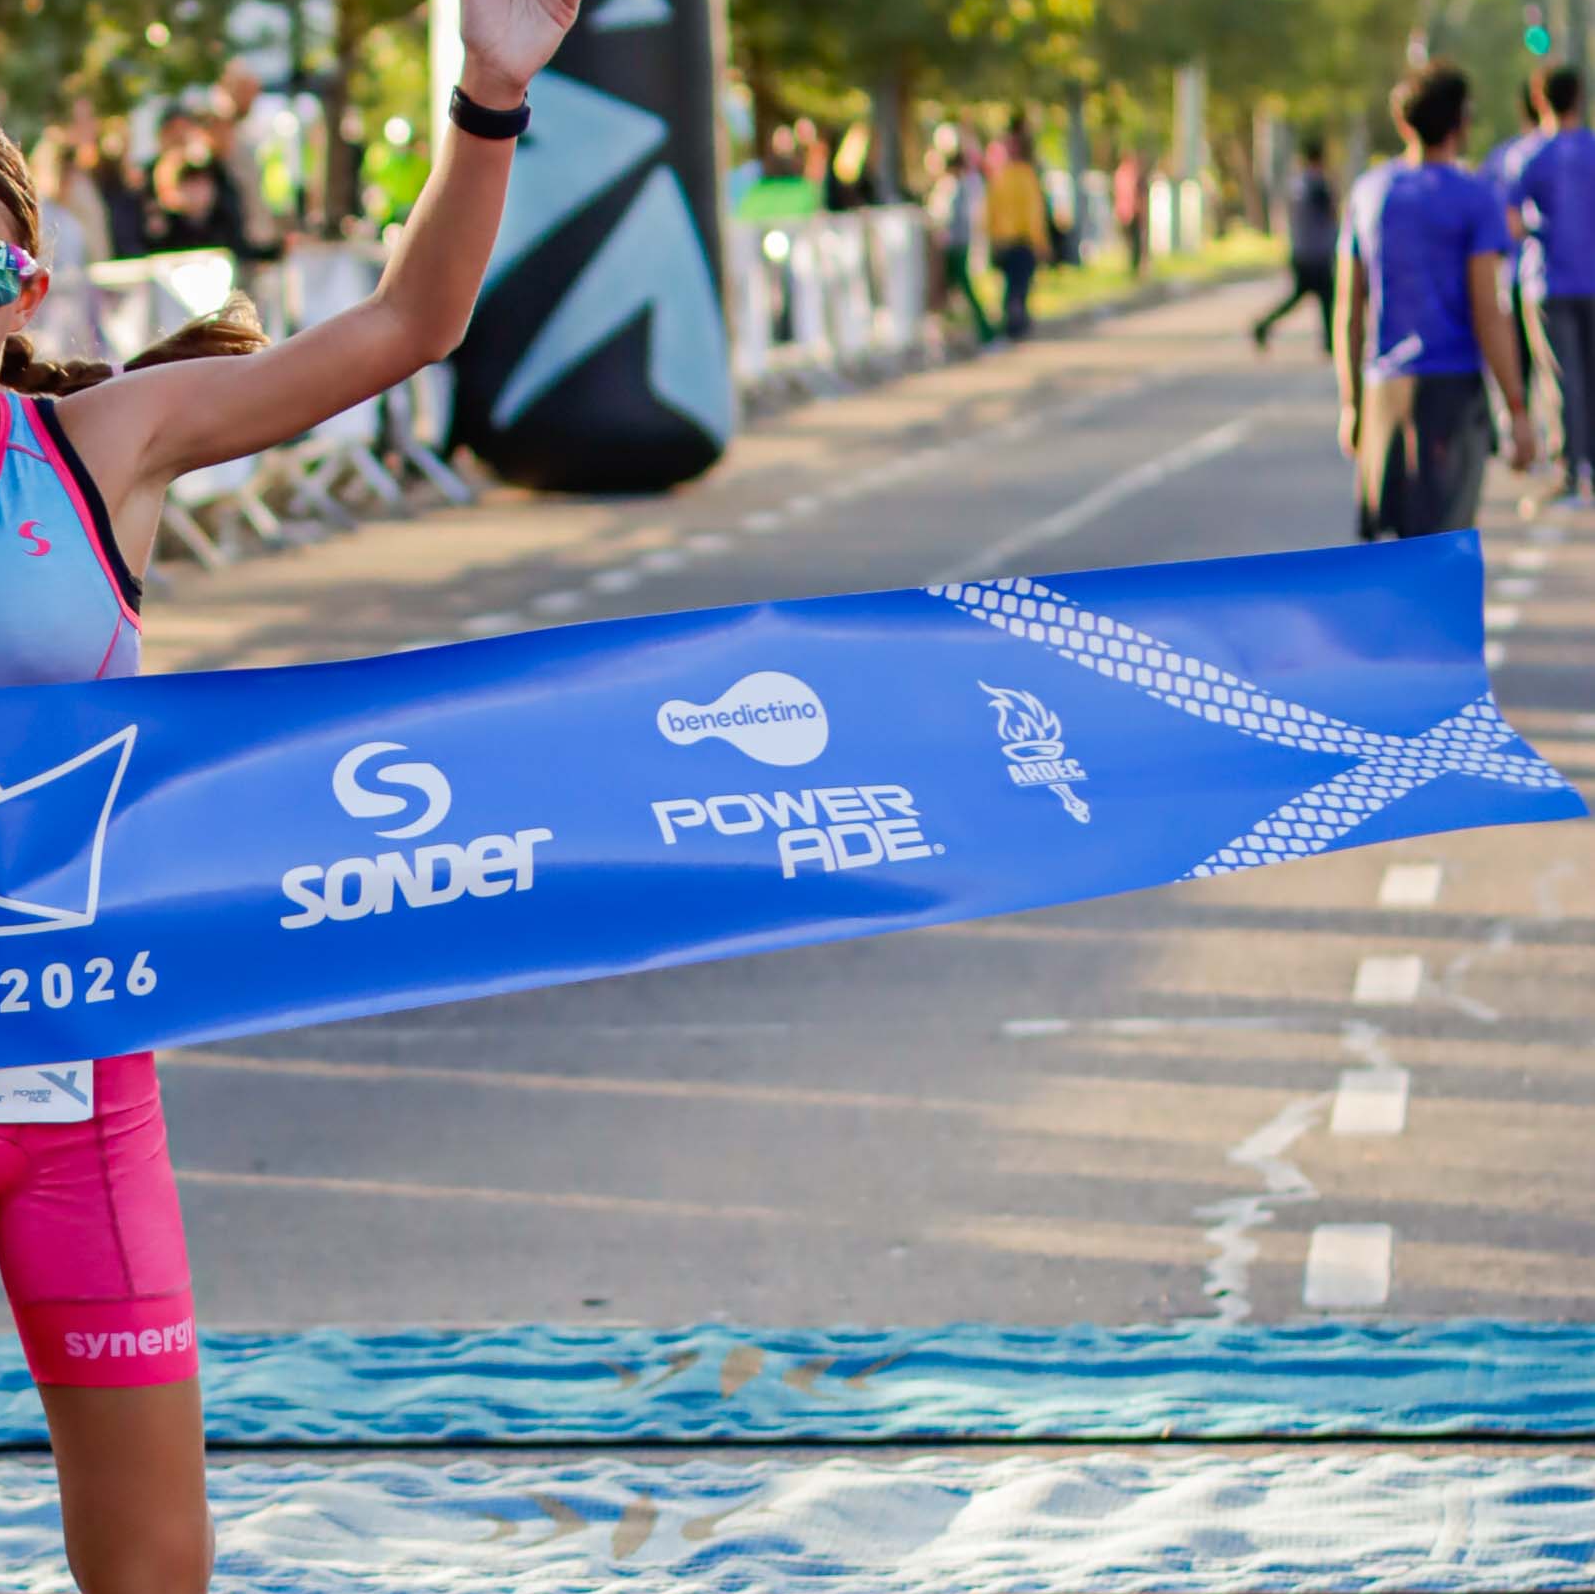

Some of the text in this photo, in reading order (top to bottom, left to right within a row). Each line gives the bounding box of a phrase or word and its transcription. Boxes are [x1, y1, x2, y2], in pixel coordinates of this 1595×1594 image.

[666, 701, 817, 733] benedictino
[1007, 758, 1087, 784] ARDEC
[651, 784, 921, 845] POWER
